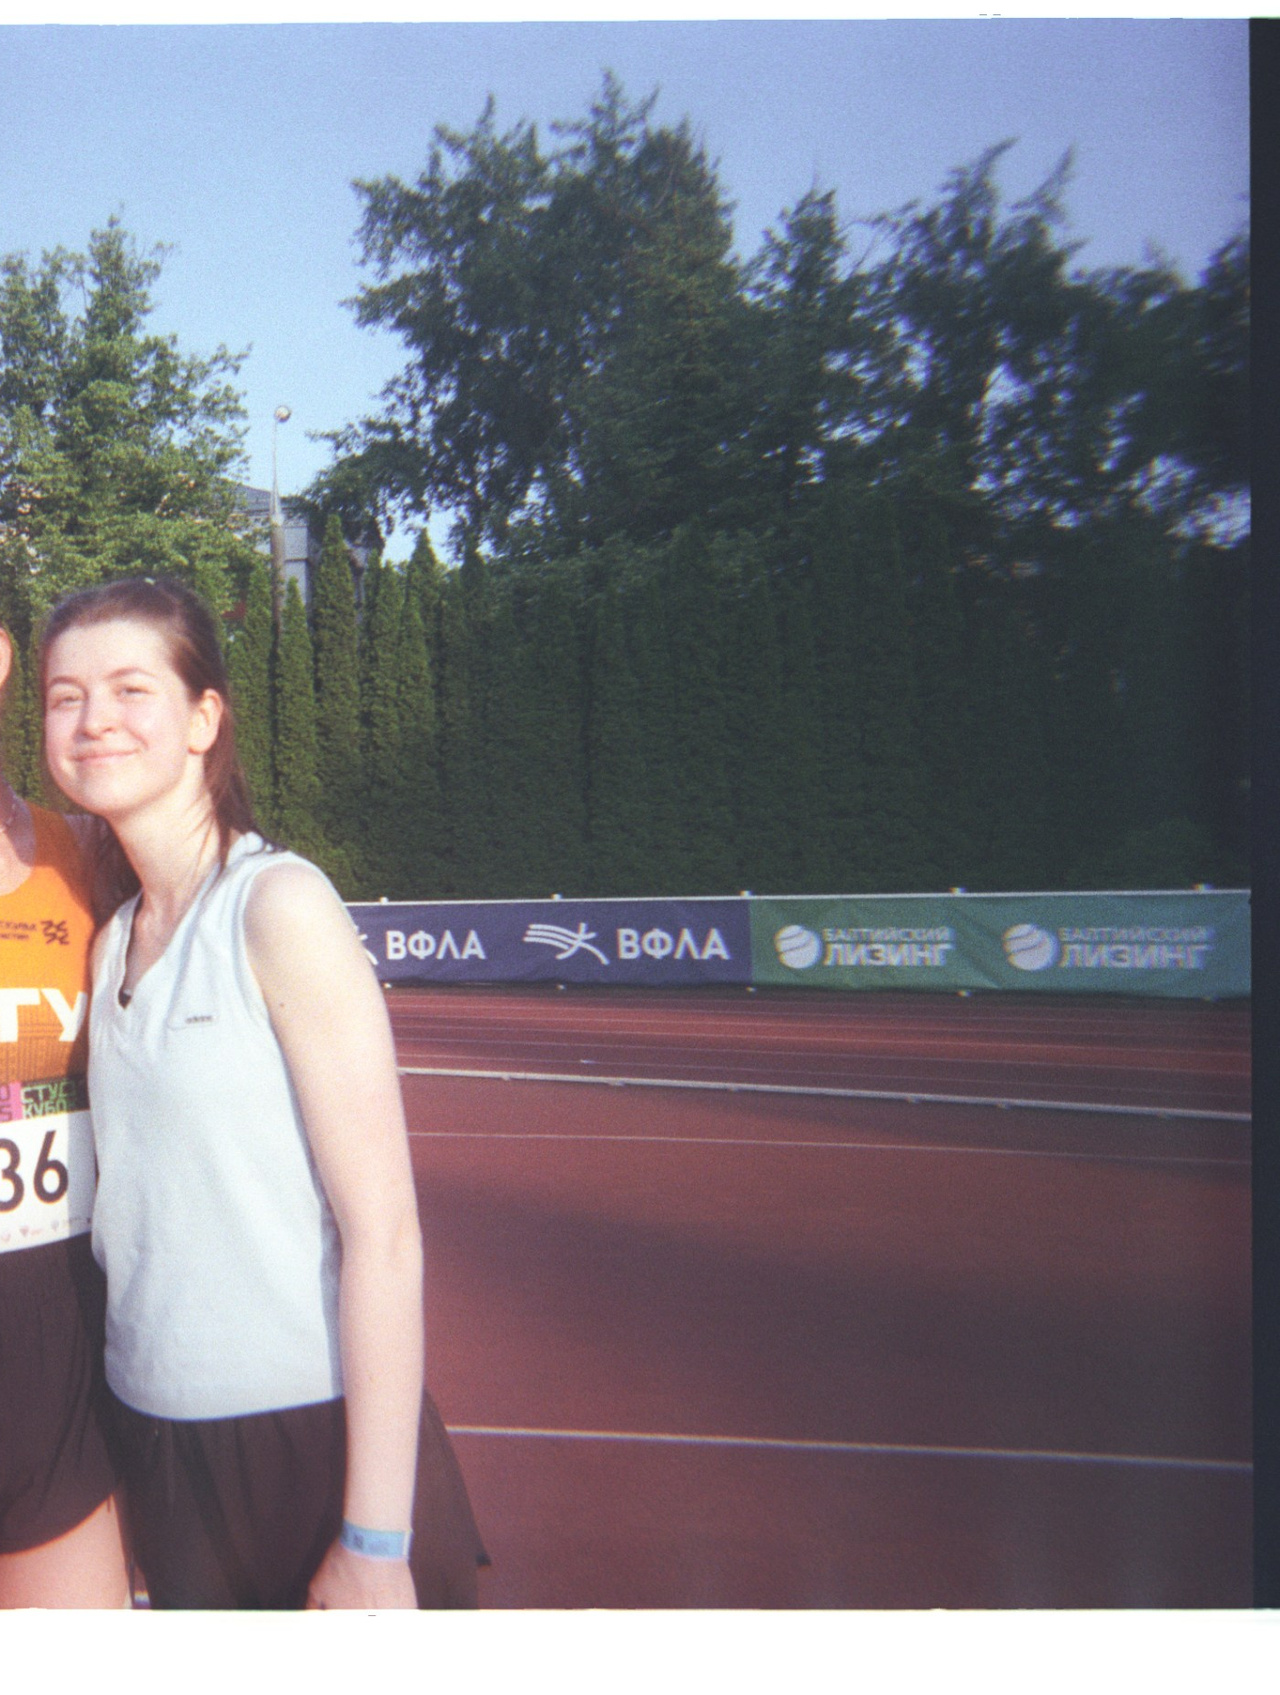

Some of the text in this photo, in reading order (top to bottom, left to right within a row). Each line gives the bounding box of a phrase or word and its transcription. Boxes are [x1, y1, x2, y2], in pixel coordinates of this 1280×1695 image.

[386, 930, 485, 960] ВФЛА
[618, 928, 731, 960] ВФЛА
[823, 942, 953, 966] ЛИЗИНГ
[1058, 943, 1211, 968] ЛИЗИНГ
